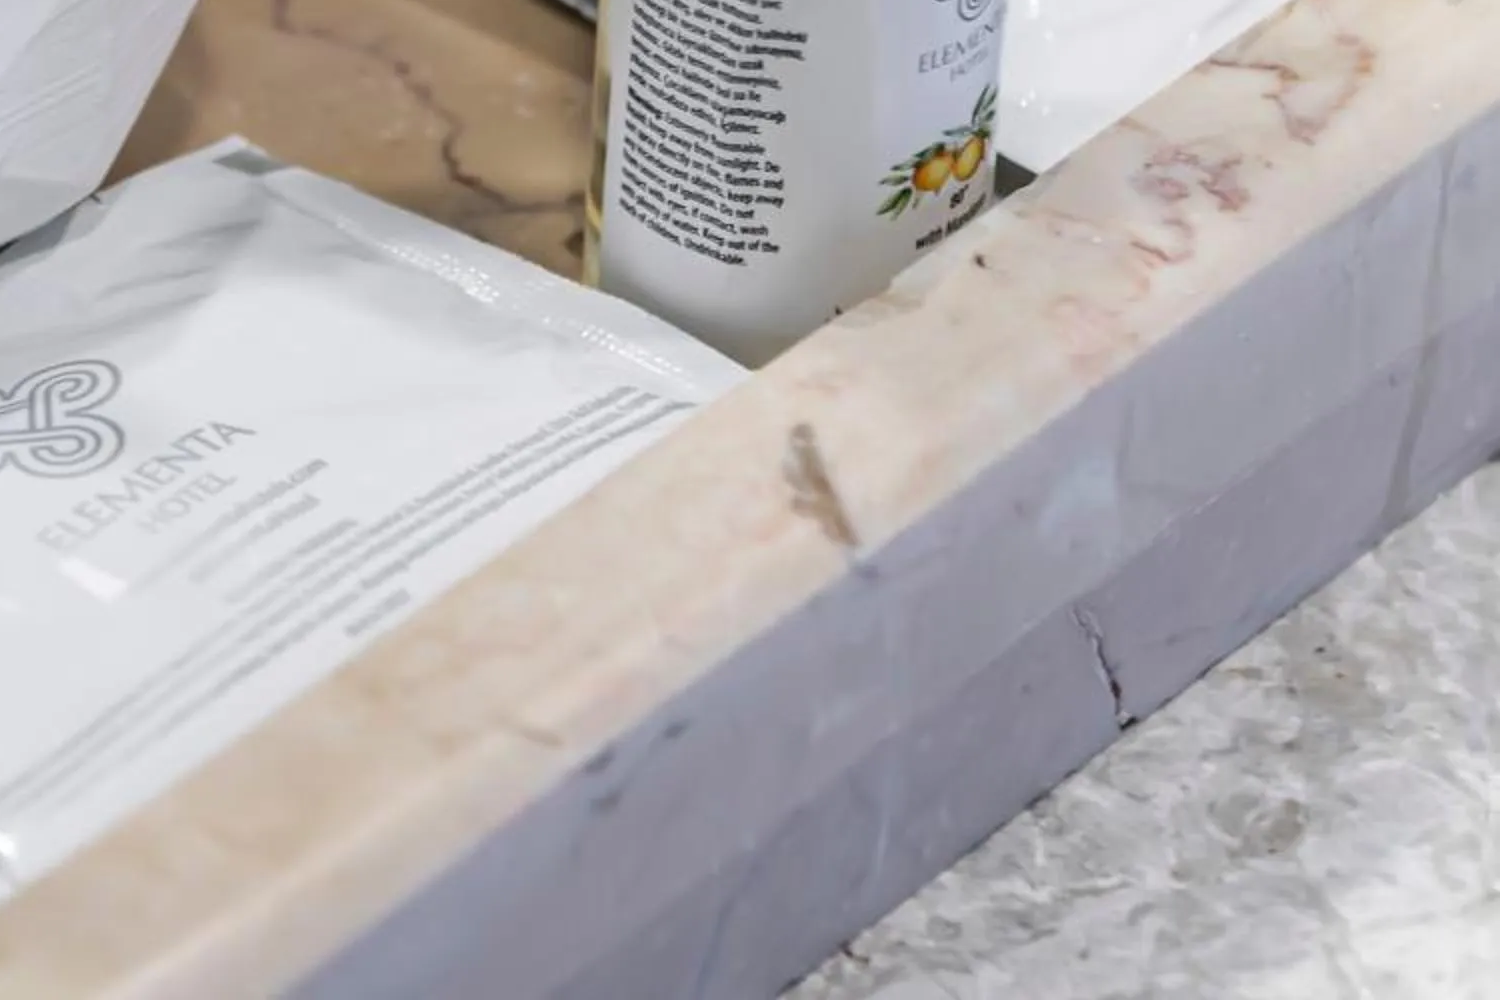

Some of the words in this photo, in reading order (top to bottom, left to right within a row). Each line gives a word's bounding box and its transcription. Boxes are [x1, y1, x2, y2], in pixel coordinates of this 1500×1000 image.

[762, 178, 784, 190] and
[734, 208, 755, 219] not
[760, 241, 780, 253] the
[36, 421, 257, 551] ELEMENTA
[135, 470, 238, 534] HOTEL
